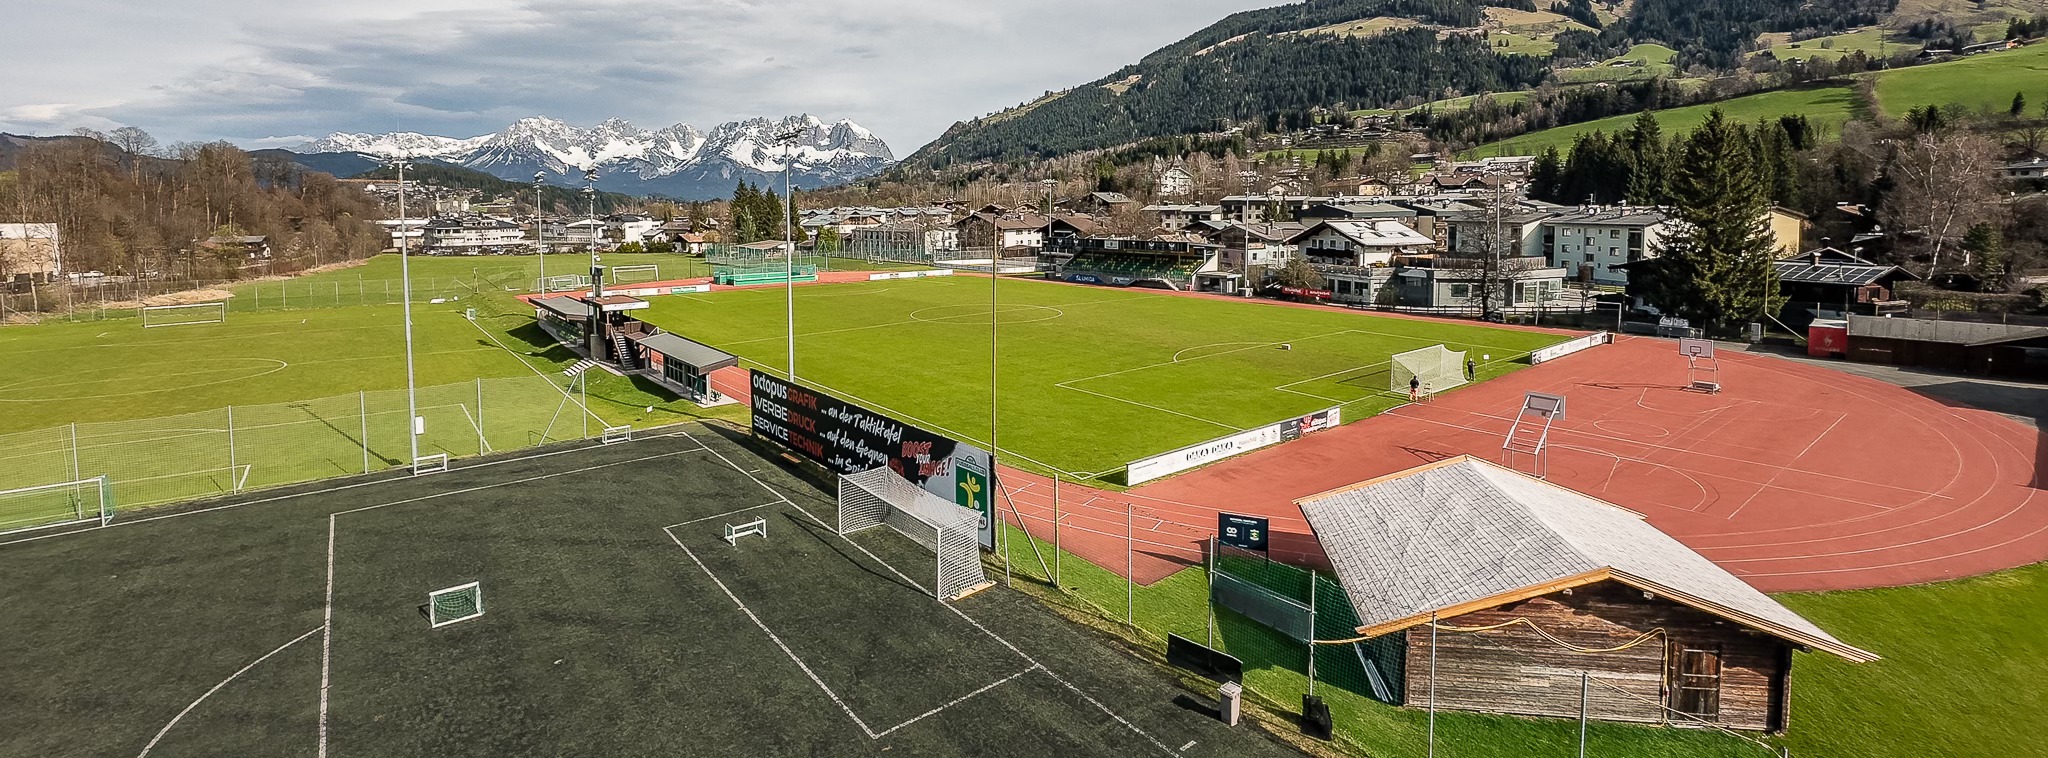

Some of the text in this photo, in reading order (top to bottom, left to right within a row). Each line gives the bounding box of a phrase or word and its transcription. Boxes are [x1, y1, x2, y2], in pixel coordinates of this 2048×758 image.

[828, 407, 838, 419] an
[839, 405, 853, 424] der
[854, 413, 903, 446] Taktiktafel
[826, 428, 840, 448] auf
[840, 430, 855, 451] den
[901, 440, 932, 459] BOOST
